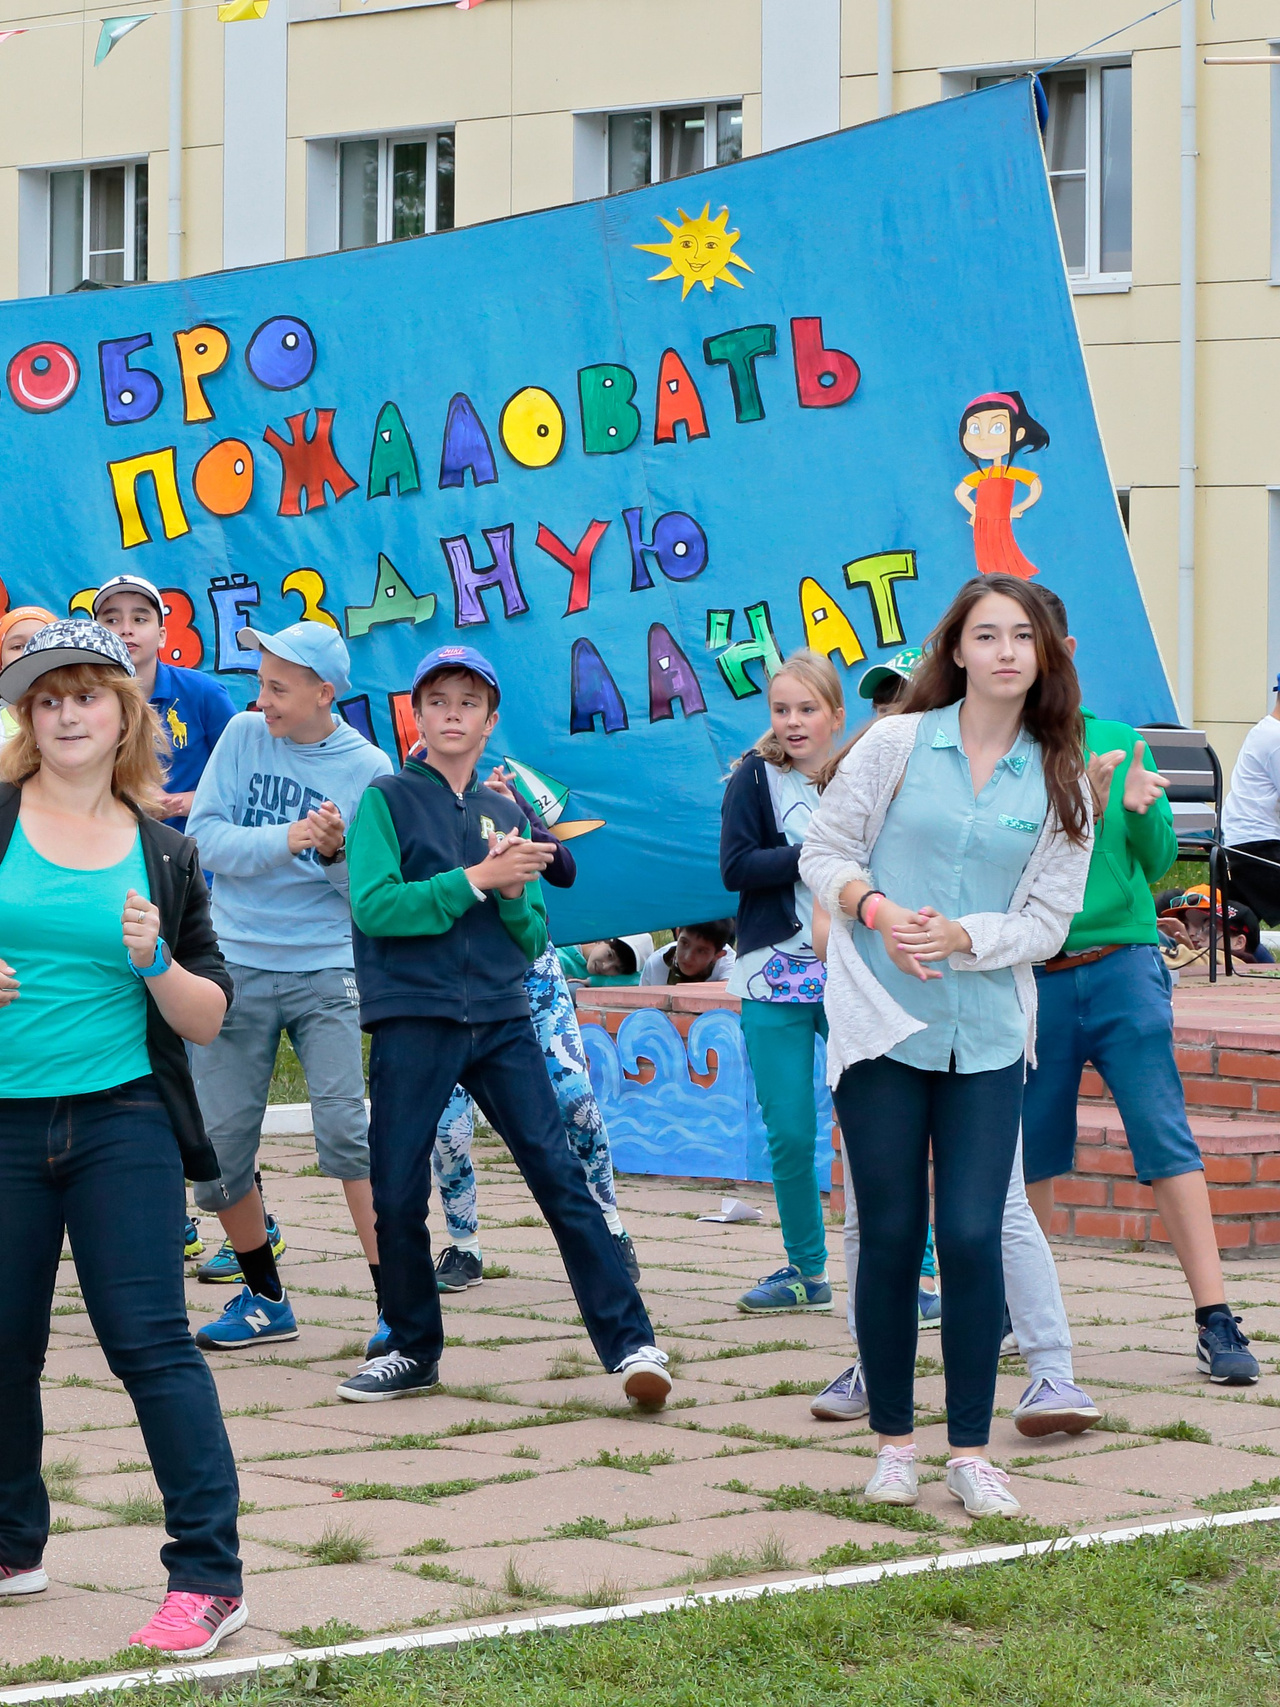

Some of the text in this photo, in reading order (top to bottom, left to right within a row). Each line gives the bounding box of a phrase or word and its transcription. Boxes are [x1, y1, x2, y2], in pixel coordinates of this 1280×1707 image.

[107, 316, 861, 550] ПОЖАЛОВАТЬ
[247, 772, 342, 821] SUPE
[244, 1308, 271, 1333] N
